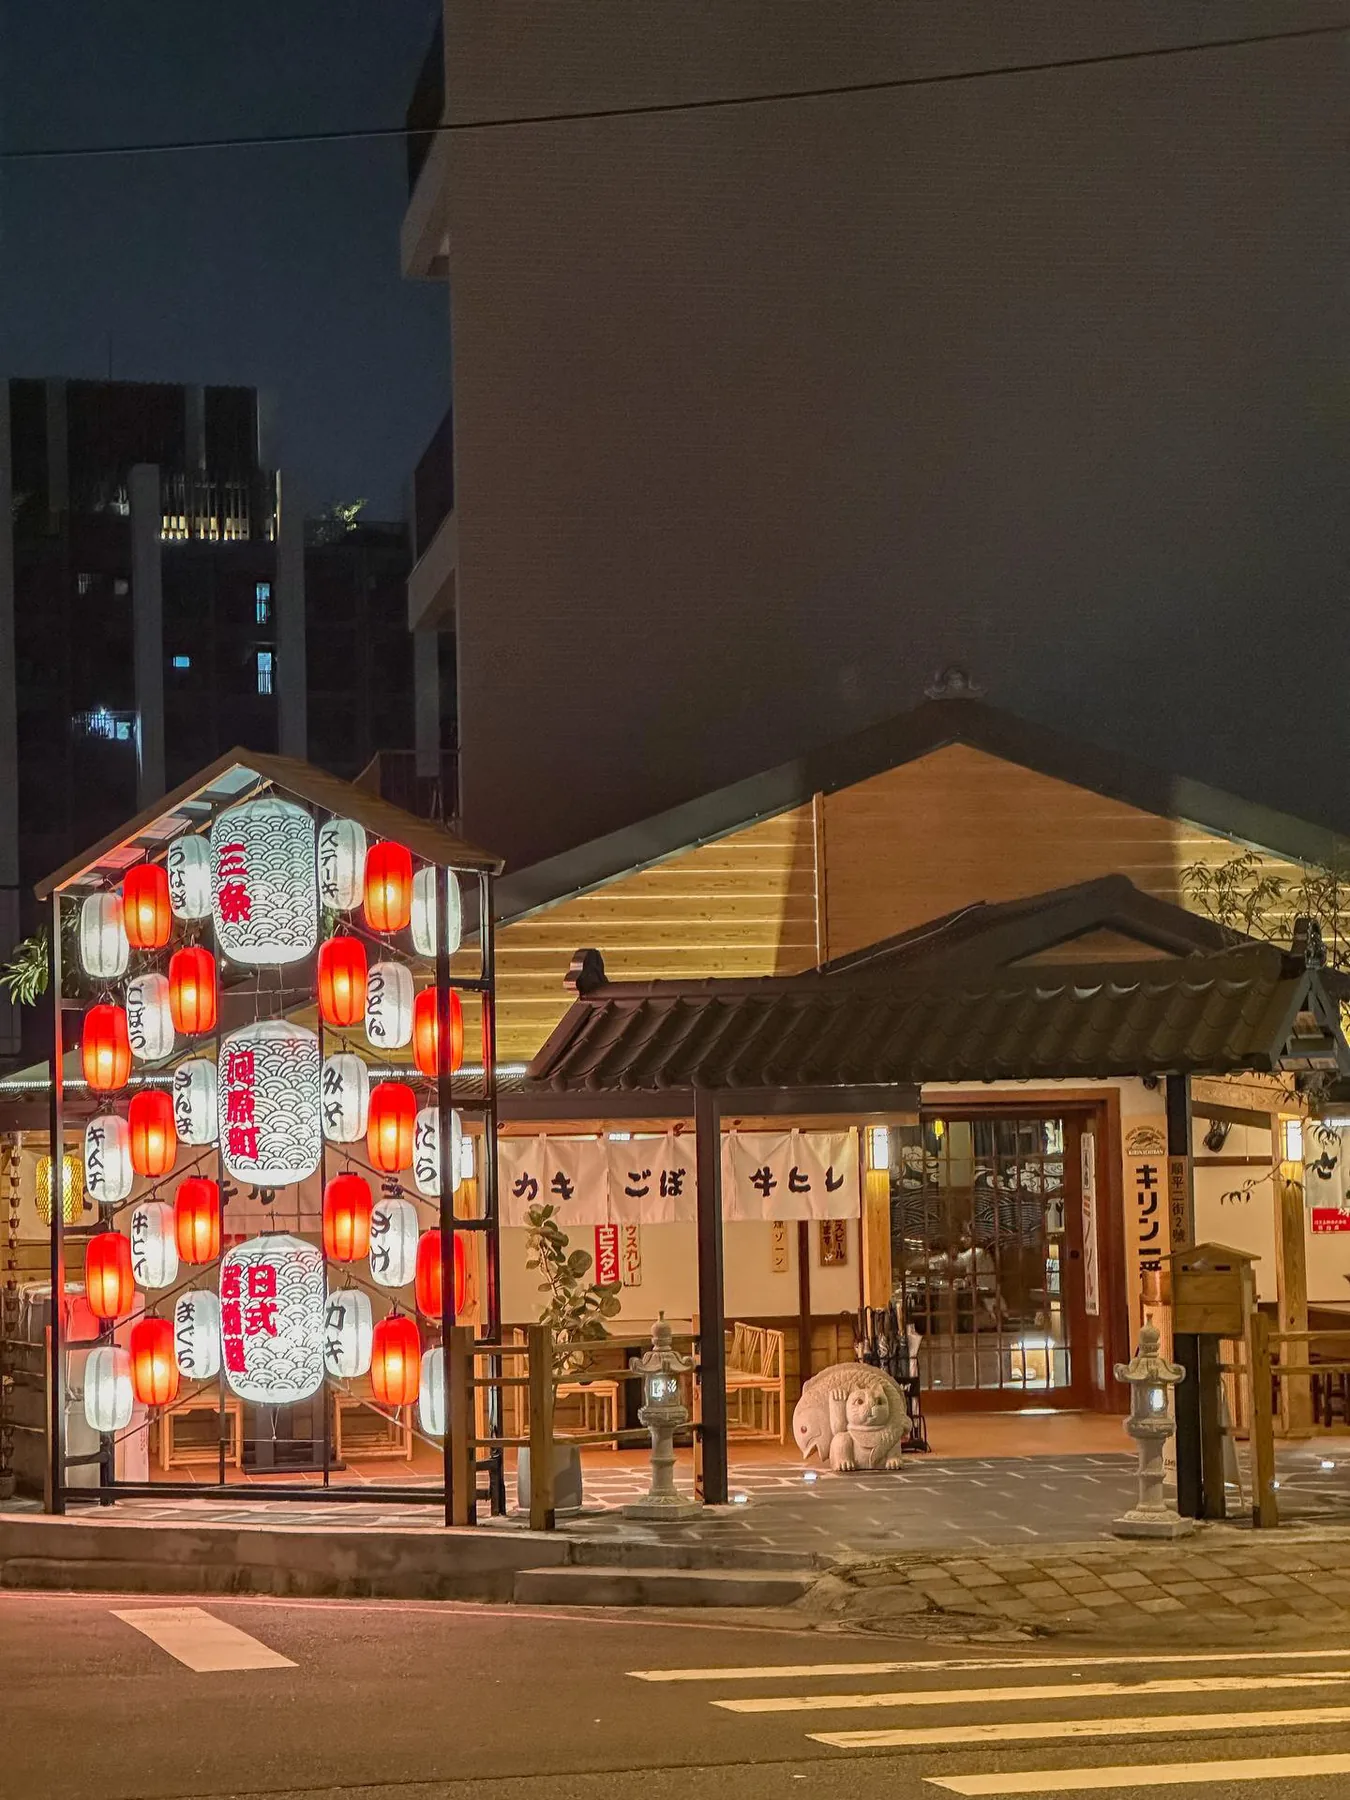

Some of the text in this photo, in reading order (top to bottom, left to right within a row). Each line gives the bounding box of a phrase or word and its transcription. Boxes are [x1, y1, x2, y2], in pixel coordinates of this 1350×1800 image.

[321, 830, 340, 898] ステーキ
[87, 1126, 106, 1191] キムチ
[512, 1171, 575, 1201] カキ
[624, 1168, 698, 1198] ごぼ
[748, 1165, 844, 1198] 牛ヒレ
[221, 1264, 249, 1373] 居酒屋
[245, 1264, 278, 1337] 日式
[324, 1302, 347, 1364] カキ
